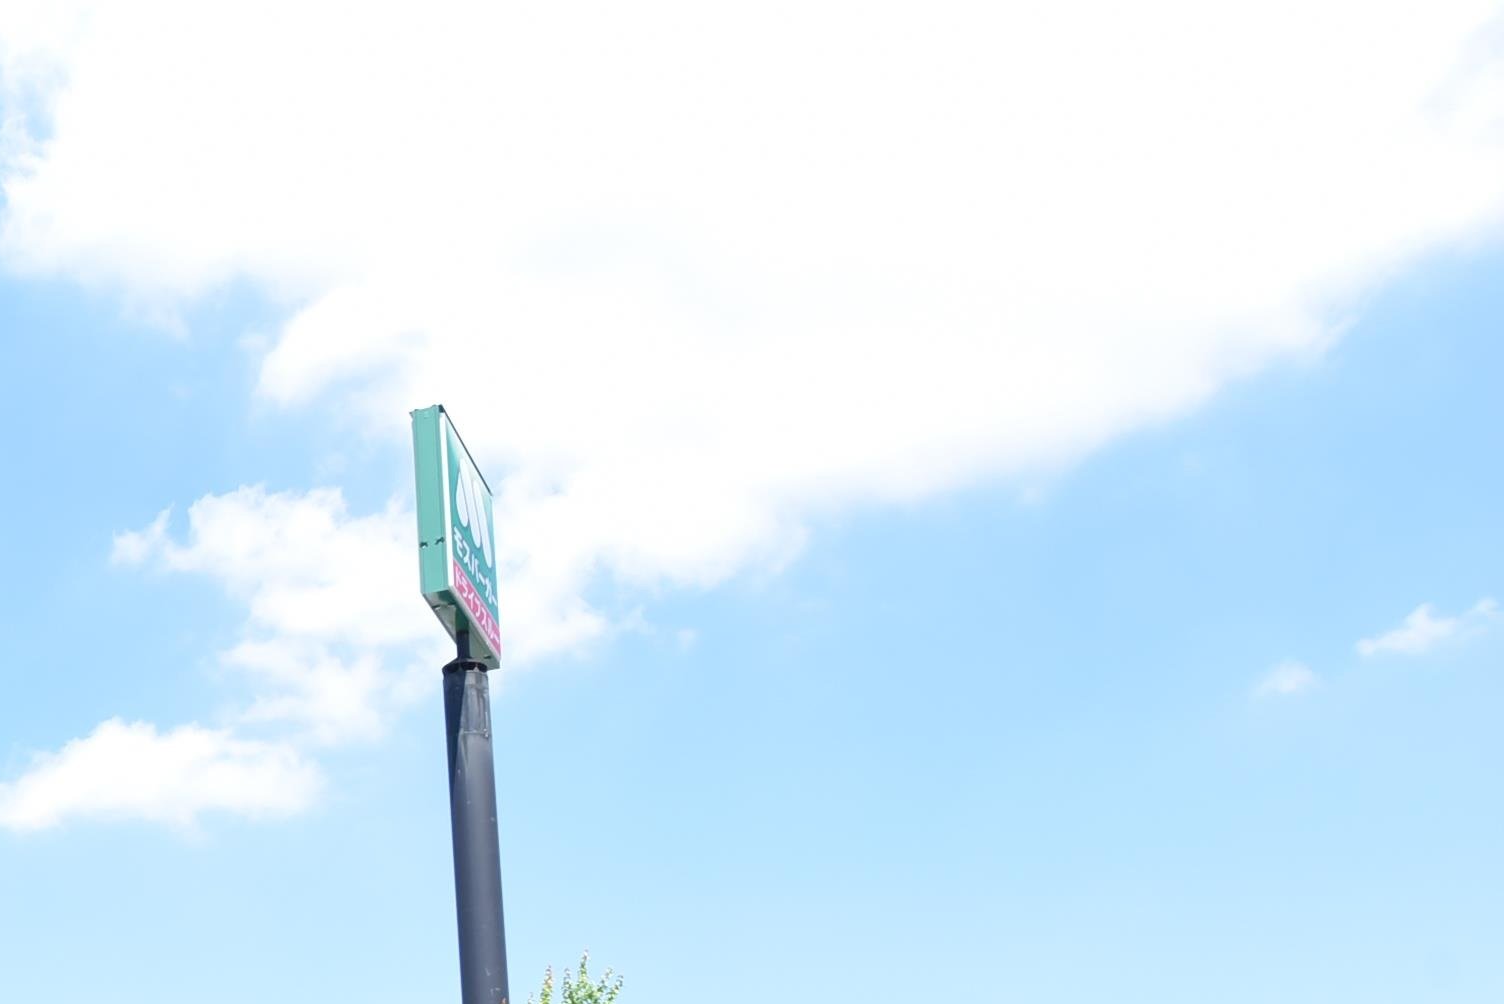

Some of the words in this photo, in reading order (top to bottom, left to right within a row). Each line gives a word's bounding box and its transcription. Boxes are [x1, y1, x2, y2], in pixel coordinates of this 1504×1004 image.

[454, 526, 497, 606] モスバーガー
